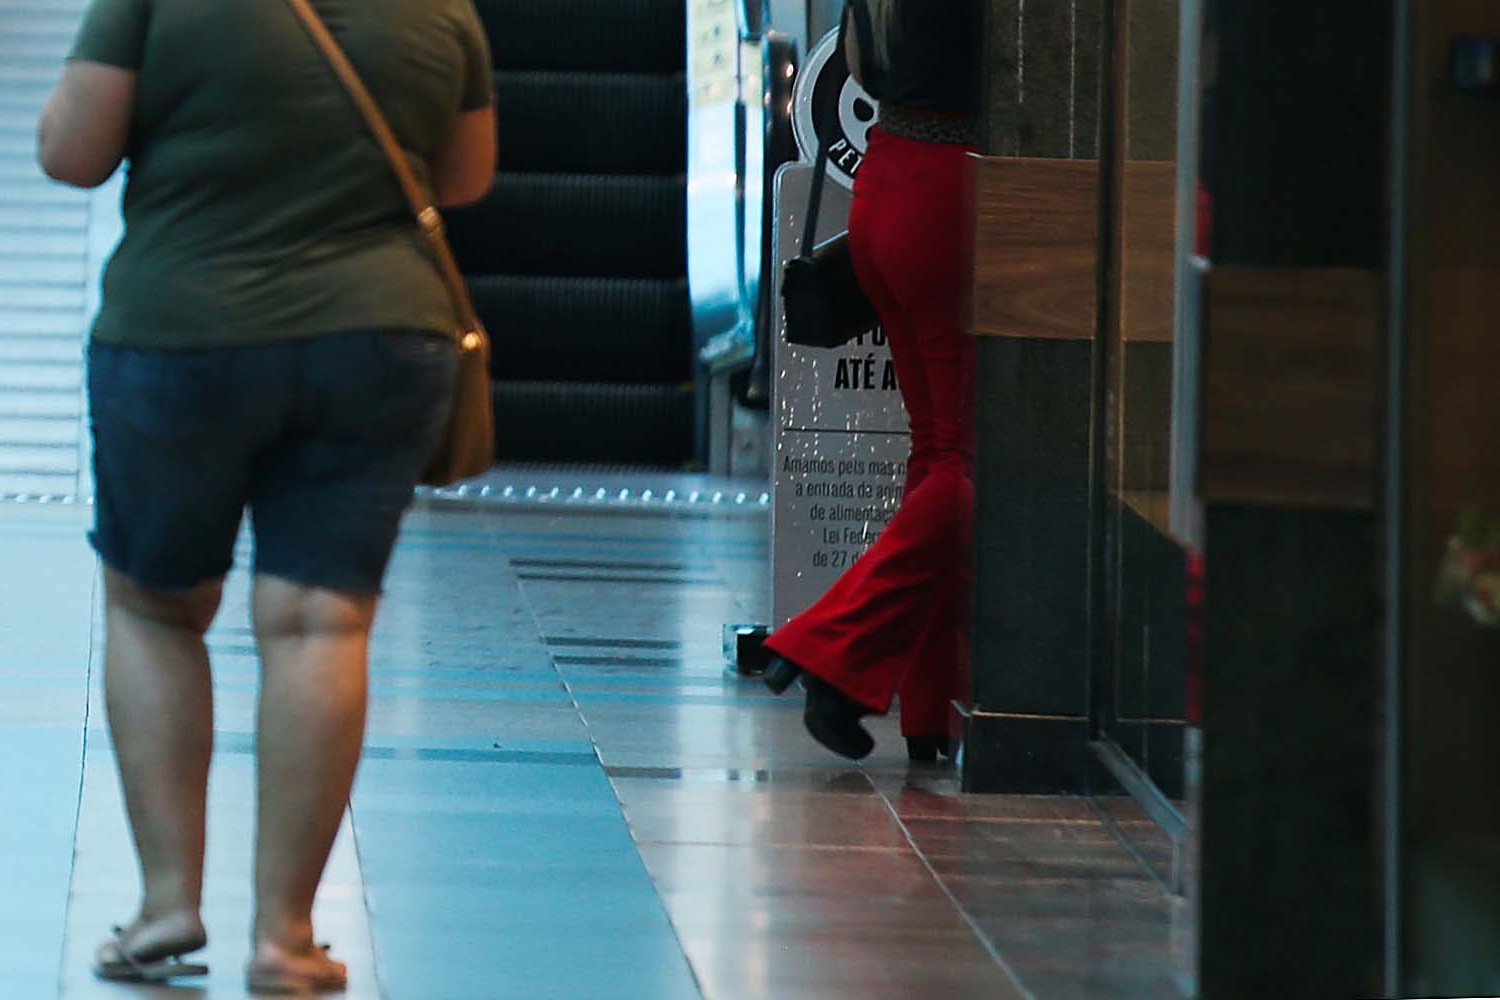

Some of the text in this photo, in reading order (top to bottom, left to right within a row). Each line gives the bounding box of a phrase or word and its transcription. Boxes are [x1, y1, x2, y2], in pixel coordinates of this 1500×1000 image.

[834, 352, 897, 391] ATÉ A
[783, 456, 835, 474] Amamos
[795, 482, 803, 497] a
[806, 481, 854, 498] entrada
[857, 482, 873, 499] de
[810, 503, 895, 525] de alimentaç
[823, 527, 881, 545] Lei Feder
[813, 550, 828, 567] de
[831, 550, 848, 568] 27
